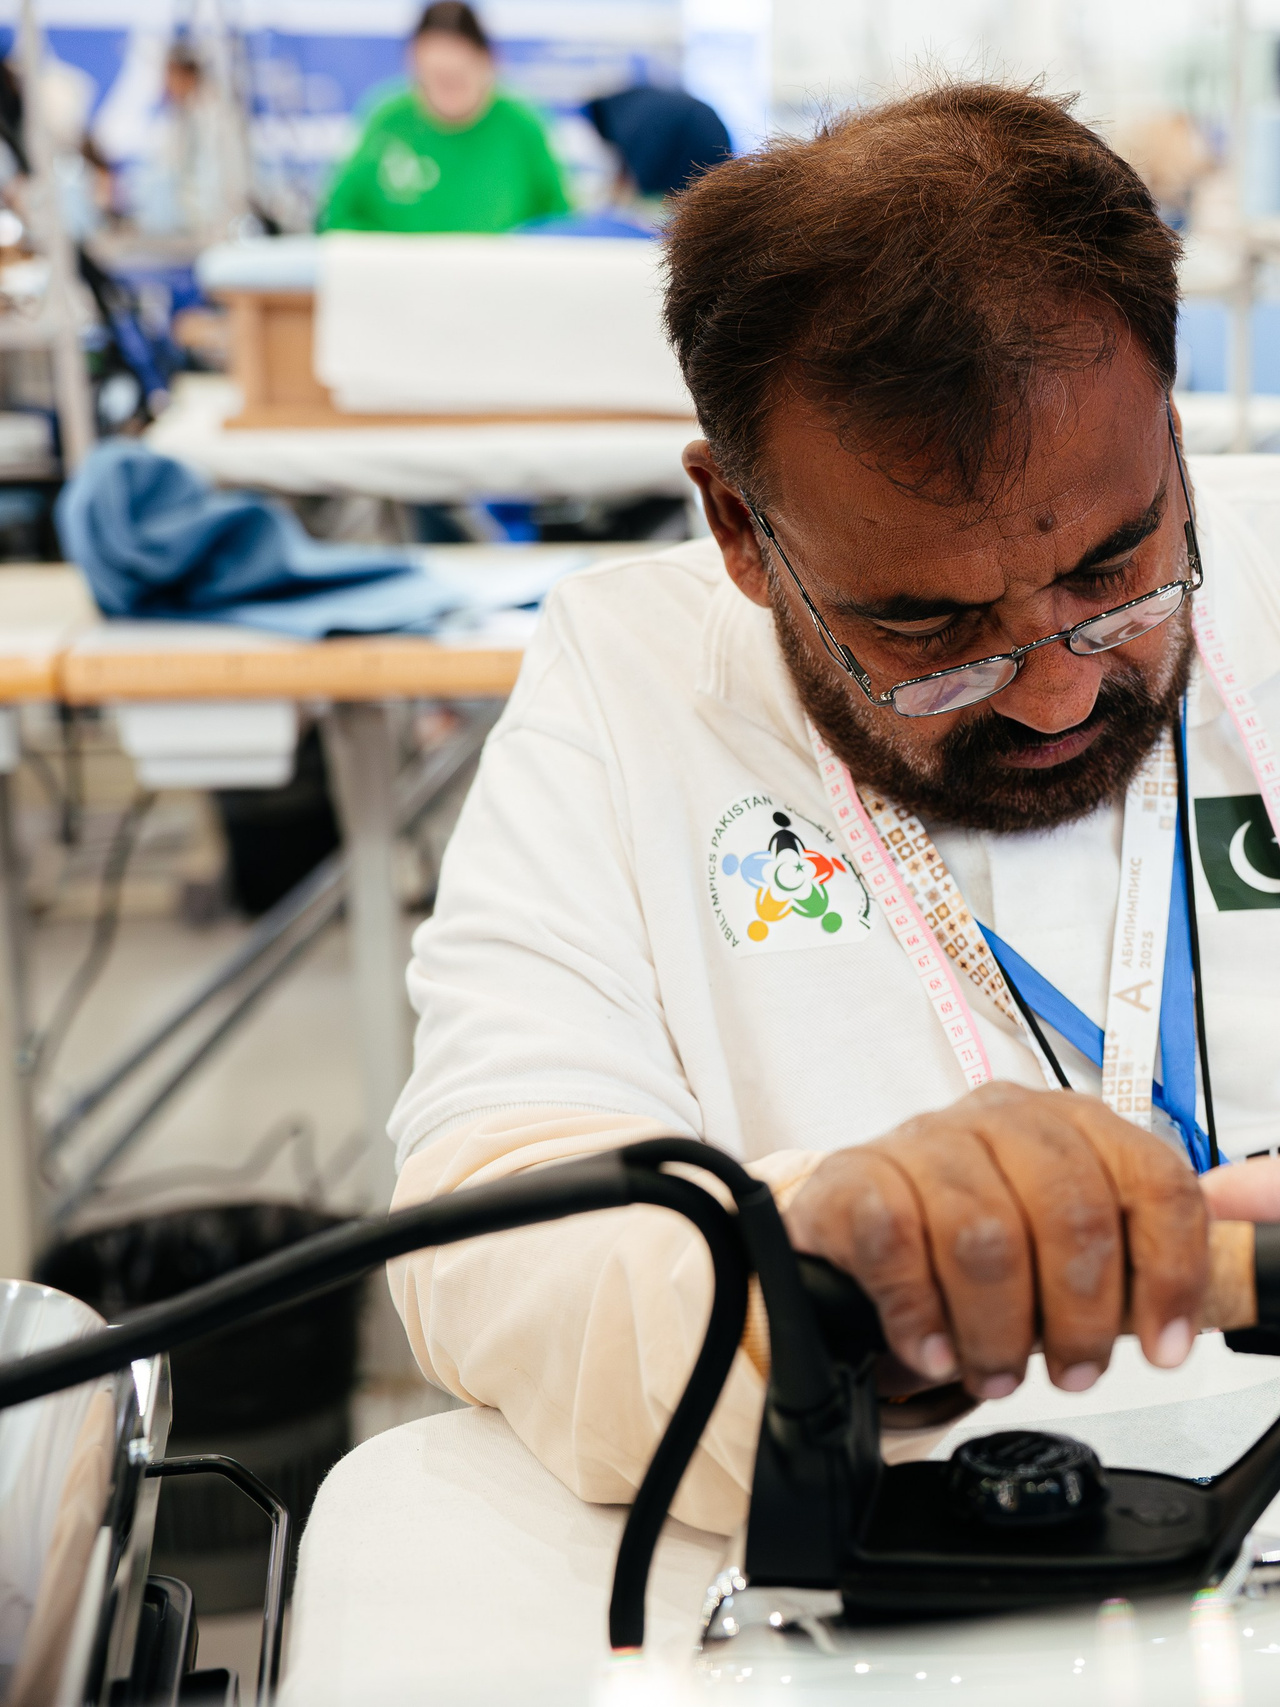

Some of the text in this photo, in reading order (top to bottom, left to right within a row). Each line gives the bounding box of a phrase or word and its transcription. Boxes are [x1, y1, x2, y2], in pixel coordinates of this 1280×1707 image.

[849, 829, 862, 841] 61
[861, 851, 873, 864] 62
[708, 795, 773, 948] ABILYMPICS PAKISTAN
[873, 873, 886, 886] 63
[884, 895, 897, 907] 64
[1121, 857, 1143, 968] АБИЛИМПИКС
[895, 915, 908, 926] 65
[906, 934, 920, 946] 66
[1140, 930, 1154, 969] 2025
[917, 955, 930, 968] 67
[929, 978, 942, 990] 68
[940, 1001, 953, 1014] 69
[951, 1025, 964, 1038] 70
[961, 1049, 974, 1061] 71
[971, 1073, 983, 1086] 72
